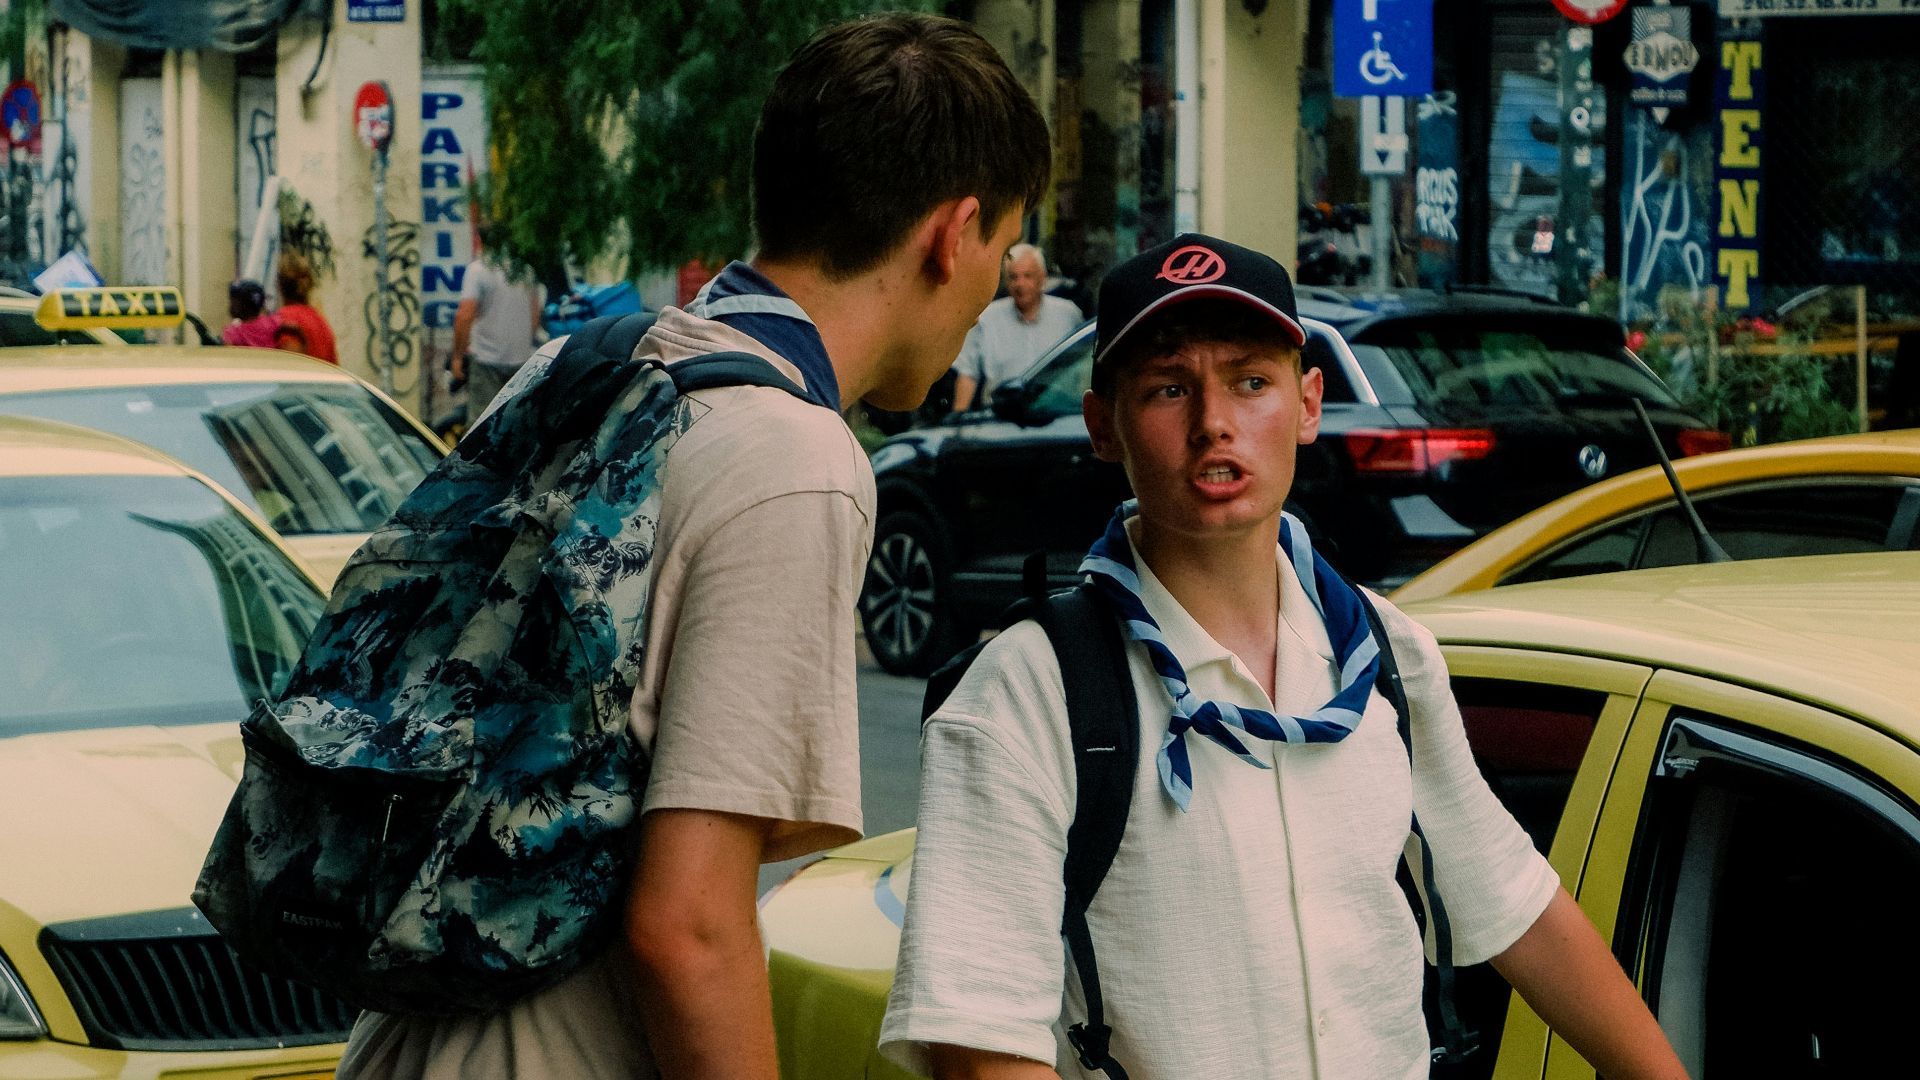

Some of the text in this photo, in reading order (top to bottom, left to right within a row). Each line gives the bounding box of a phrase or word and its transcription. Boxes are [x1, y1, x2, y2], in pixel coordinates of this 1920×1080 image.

[421, 93, 466, 328] PARKING
[1718, 41, 1762, 308] TENT
[72, 292, 166, 316] TAXI
[282, 911, 343, 930] EASTPAK
